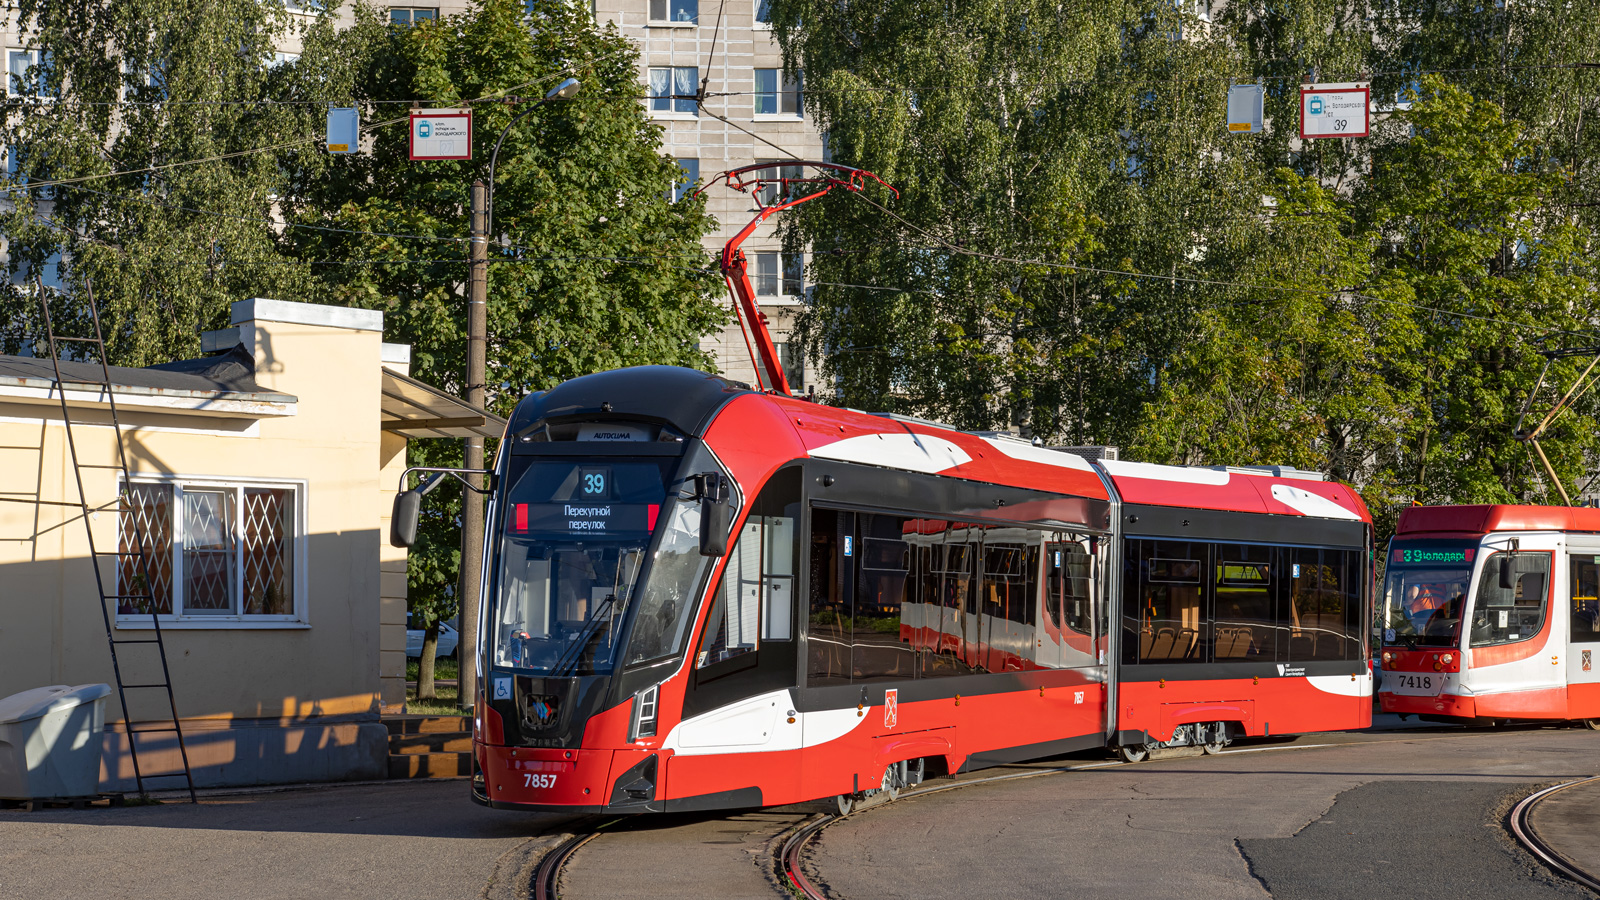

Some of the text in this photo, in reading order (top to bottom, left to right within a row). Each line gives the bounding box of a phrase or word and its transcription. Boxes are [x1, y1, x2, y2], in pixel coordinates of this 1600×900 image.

[1334, 119, 1348, 131] 39
[584, 473, 605, 494] 39
[564, 504, 611, 518] Перекупной
[568, 520, 606, 530] переулок
[1398, 675, 1432, 689] 7418
[523, 773, 557, 789] 7857
